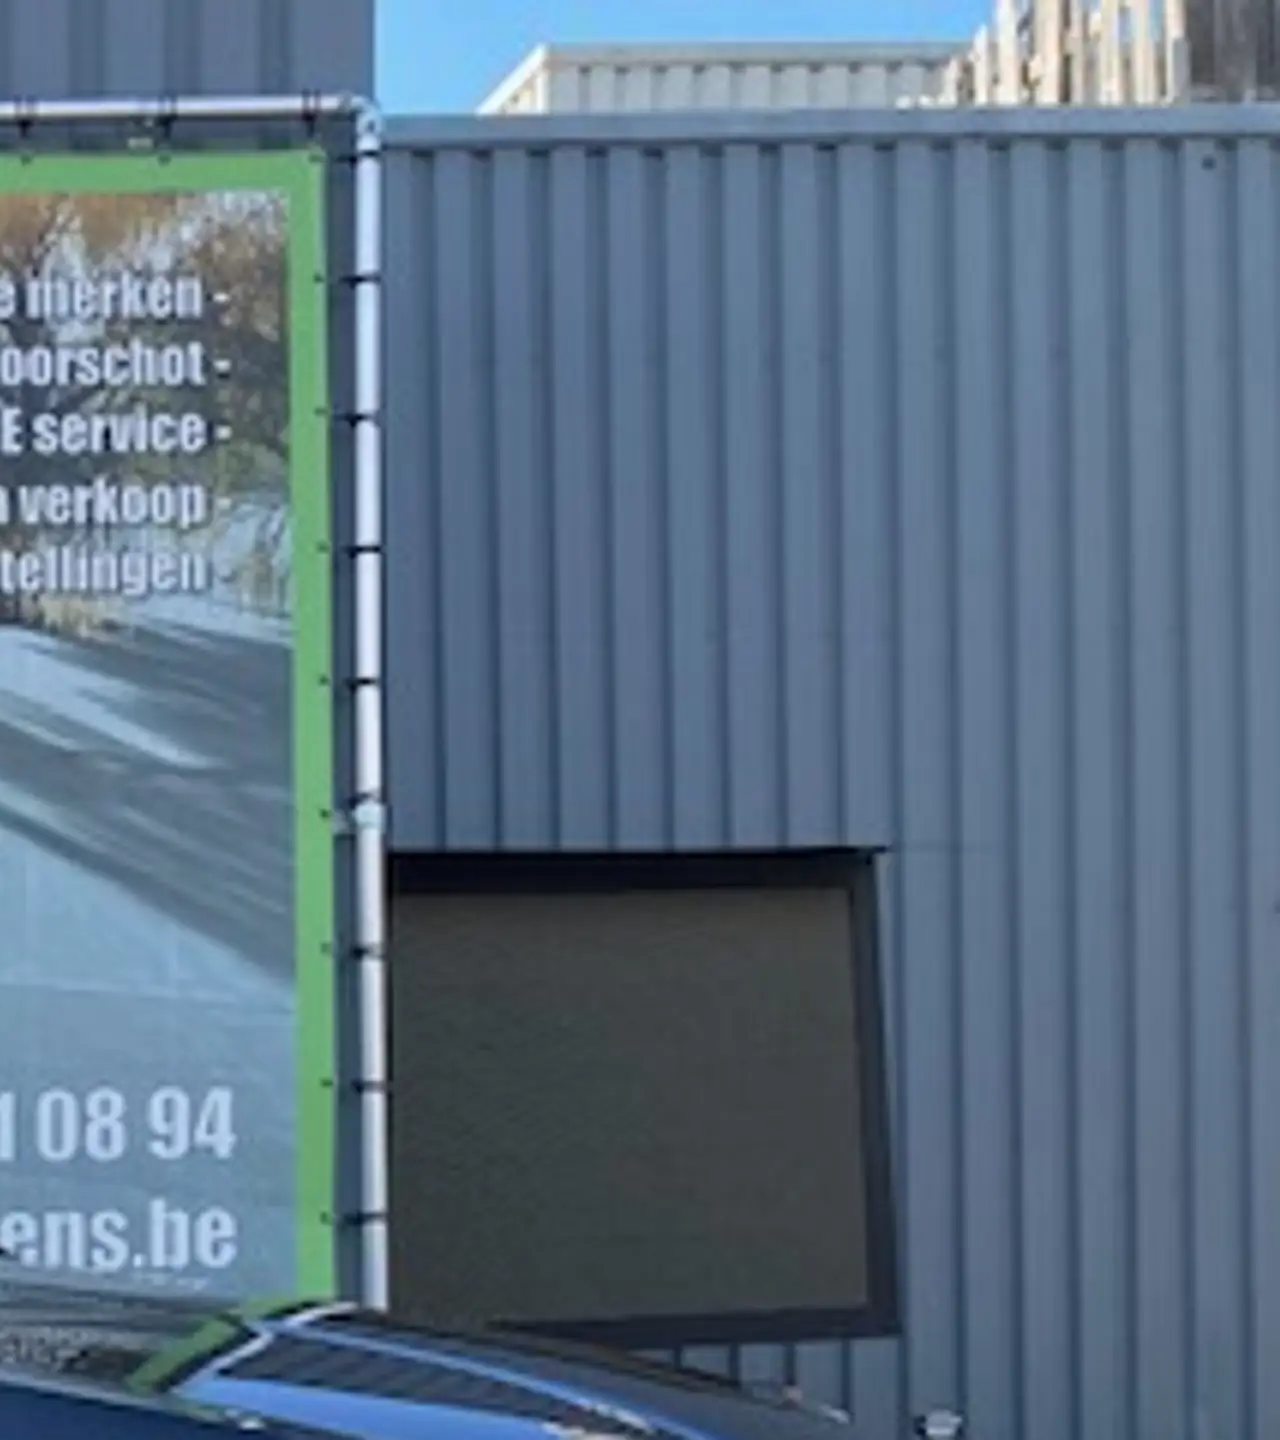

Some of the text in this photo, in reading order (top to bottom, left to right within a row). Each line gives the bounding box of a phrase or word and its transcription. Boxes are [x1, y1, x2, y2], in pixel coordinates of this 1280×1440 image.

[28, 274, 204, 320] merken
[32, 408, 208, 454] service
[18, 482, 208, 530] verkoop
[37, 1086, 126, 1162] 08
[148, 1086, 236, 1160] 94
